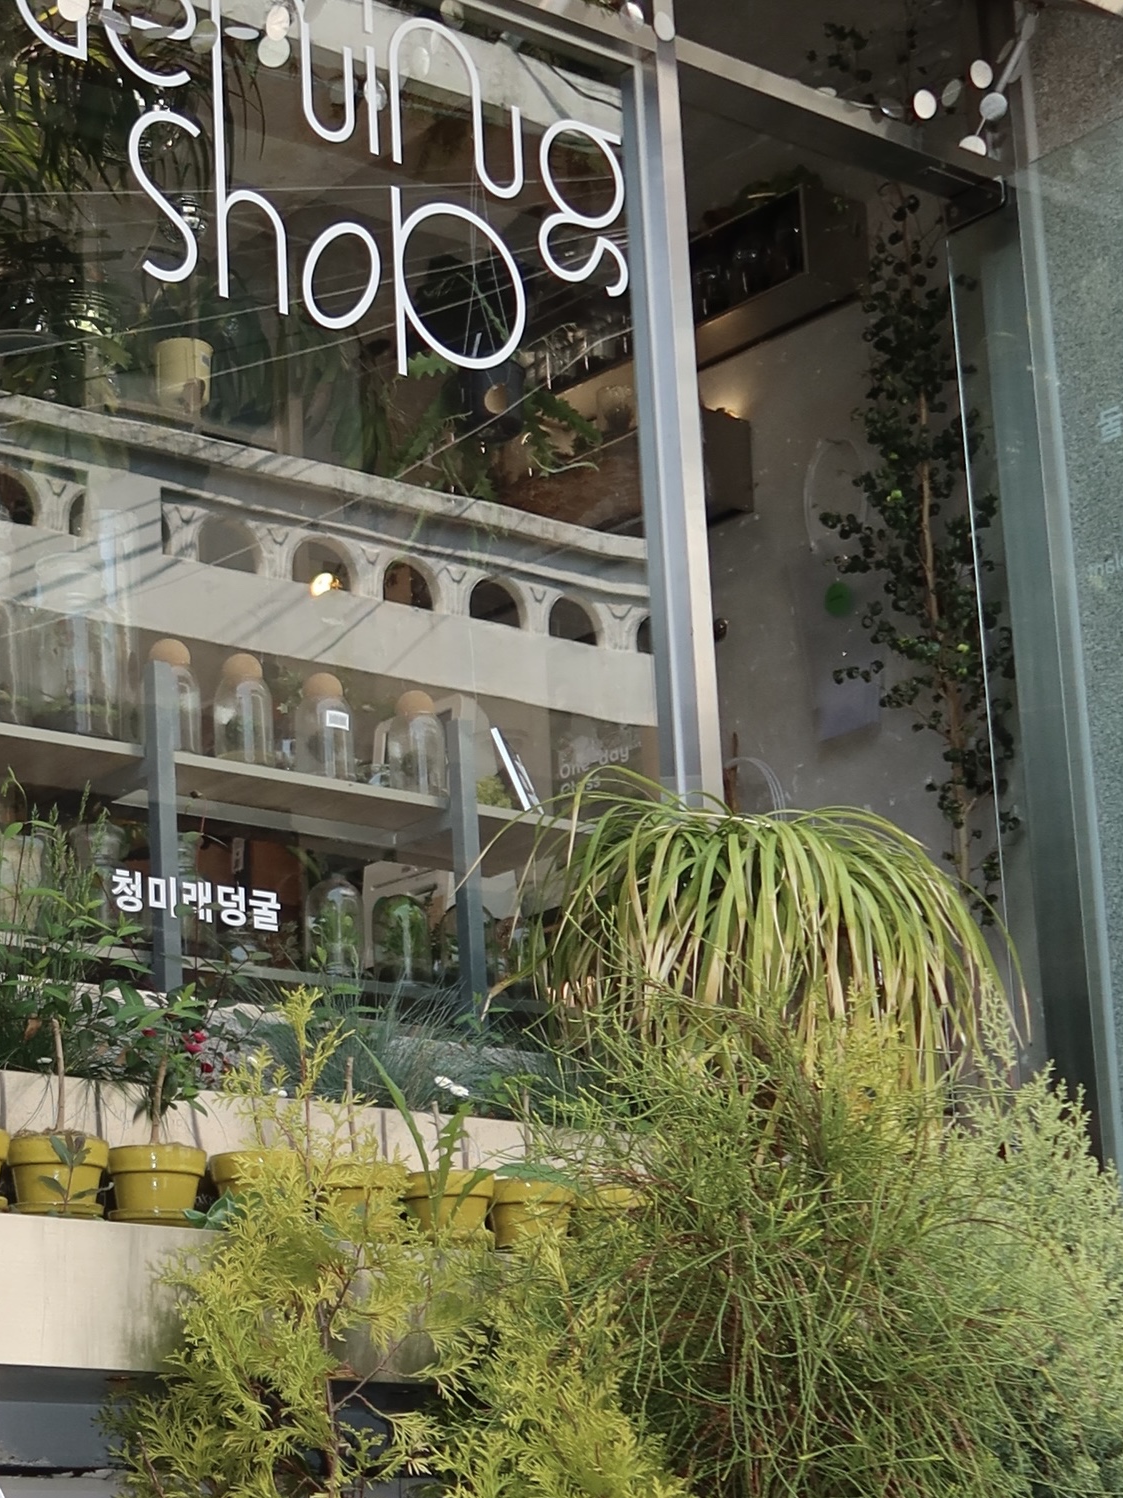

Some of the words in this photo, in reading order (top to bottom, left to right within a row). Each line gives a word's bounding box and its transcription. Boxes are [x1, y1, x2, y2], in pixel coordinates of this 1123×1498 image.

[128, 100, 527, 377] shop
[560, 775, 601, 796] Clss
[111, 868, 282, 932] 청미래덩굴
